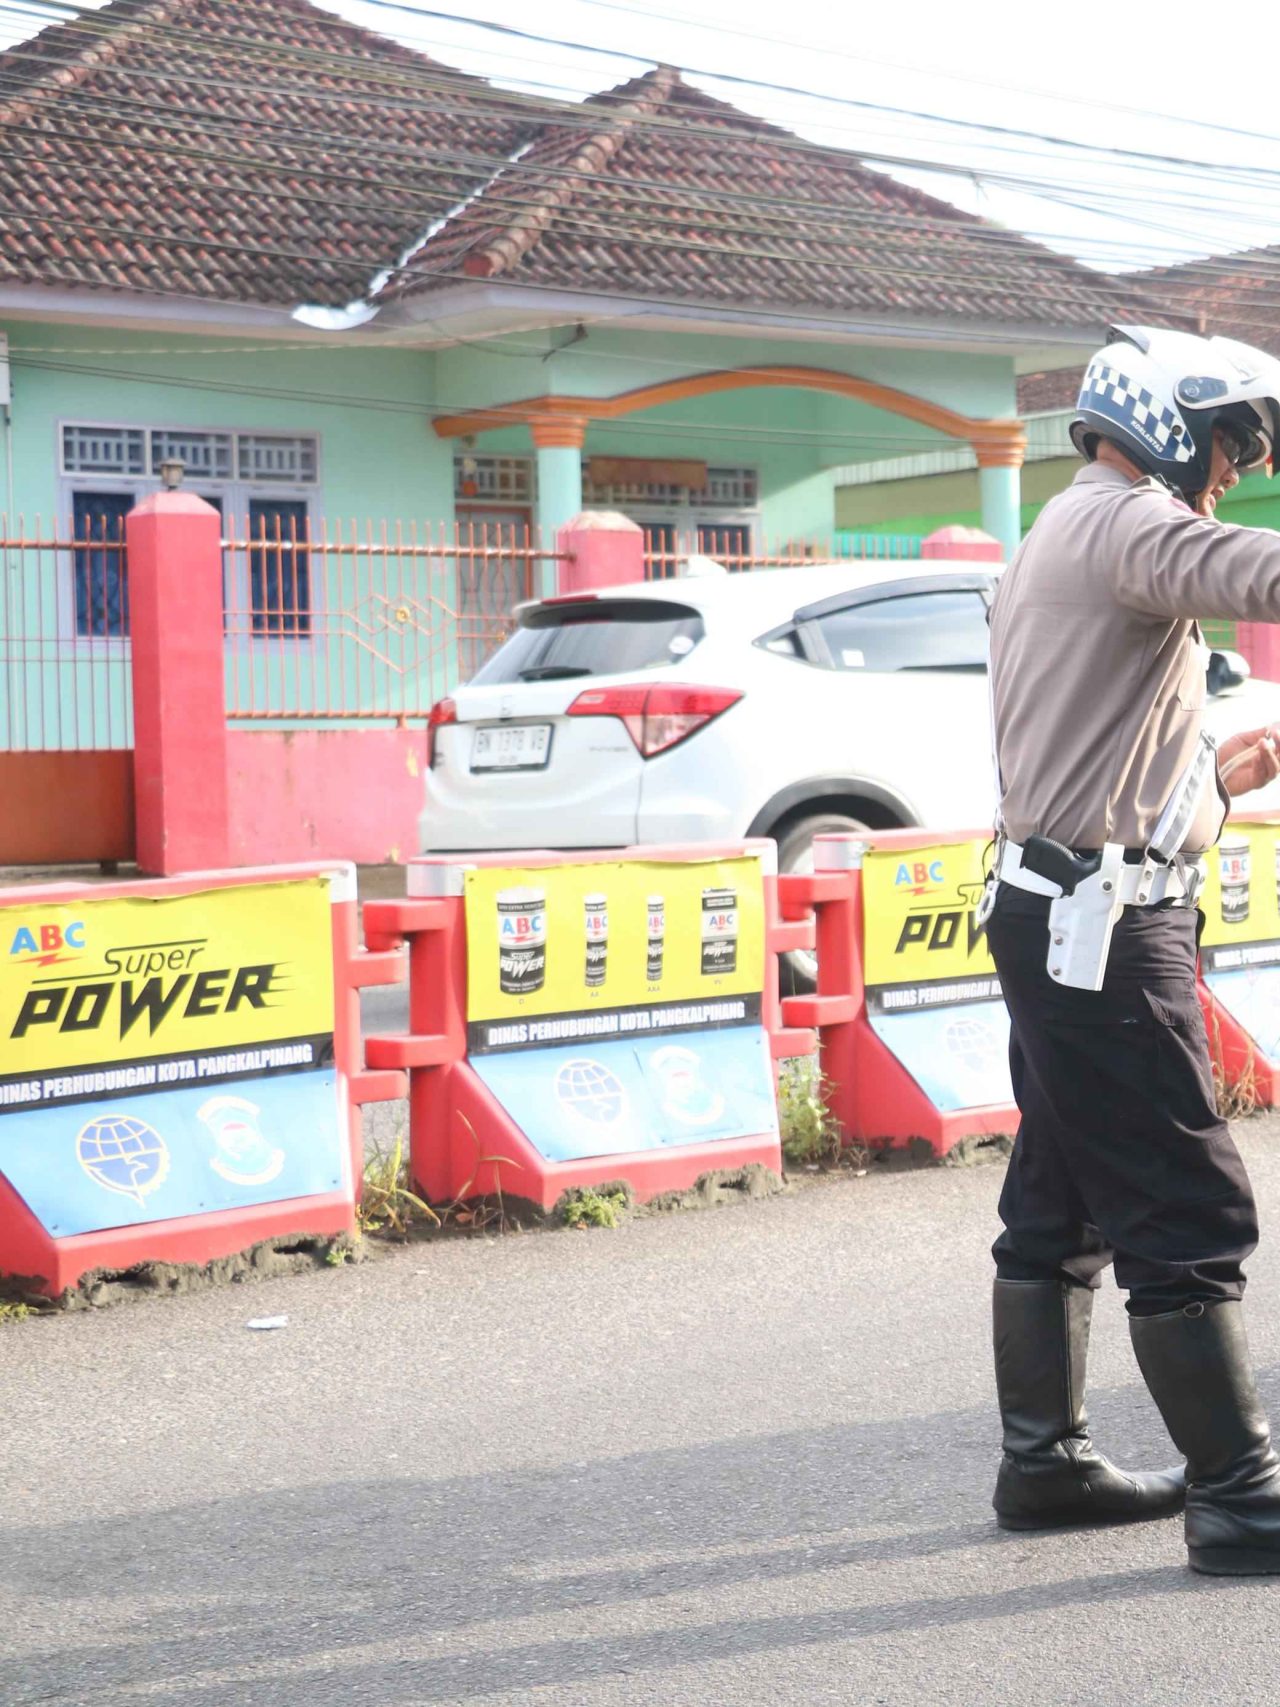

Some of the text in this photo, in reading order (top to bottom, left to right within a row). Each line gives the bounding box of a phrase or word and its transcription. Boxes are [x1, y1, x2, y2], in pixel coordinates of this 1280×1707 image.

[1131, 420, 1164, 452] KORLANTAS
[895, 861, 944, 885] ABC
[503, 915, 543, 935] ABC
[586, 916, 607, 929] ABC
[709, 914, 733, 926] ABC
[10, 922, 85, 955] ABC
[104, 939, 207, 978] Super
[500, 957, 544, 979] POWER
[9, 962, 280, 1042] POWER
[883, 989, 917, 1008] DINAS
[488, 1001, 745, 1046] DINAS PERHUBUNGAN KOTA PANGKALPINANG
[0, 1044, 313, 1105] INAS PERHUBUNGAN KOTA PANGKALPINANG
